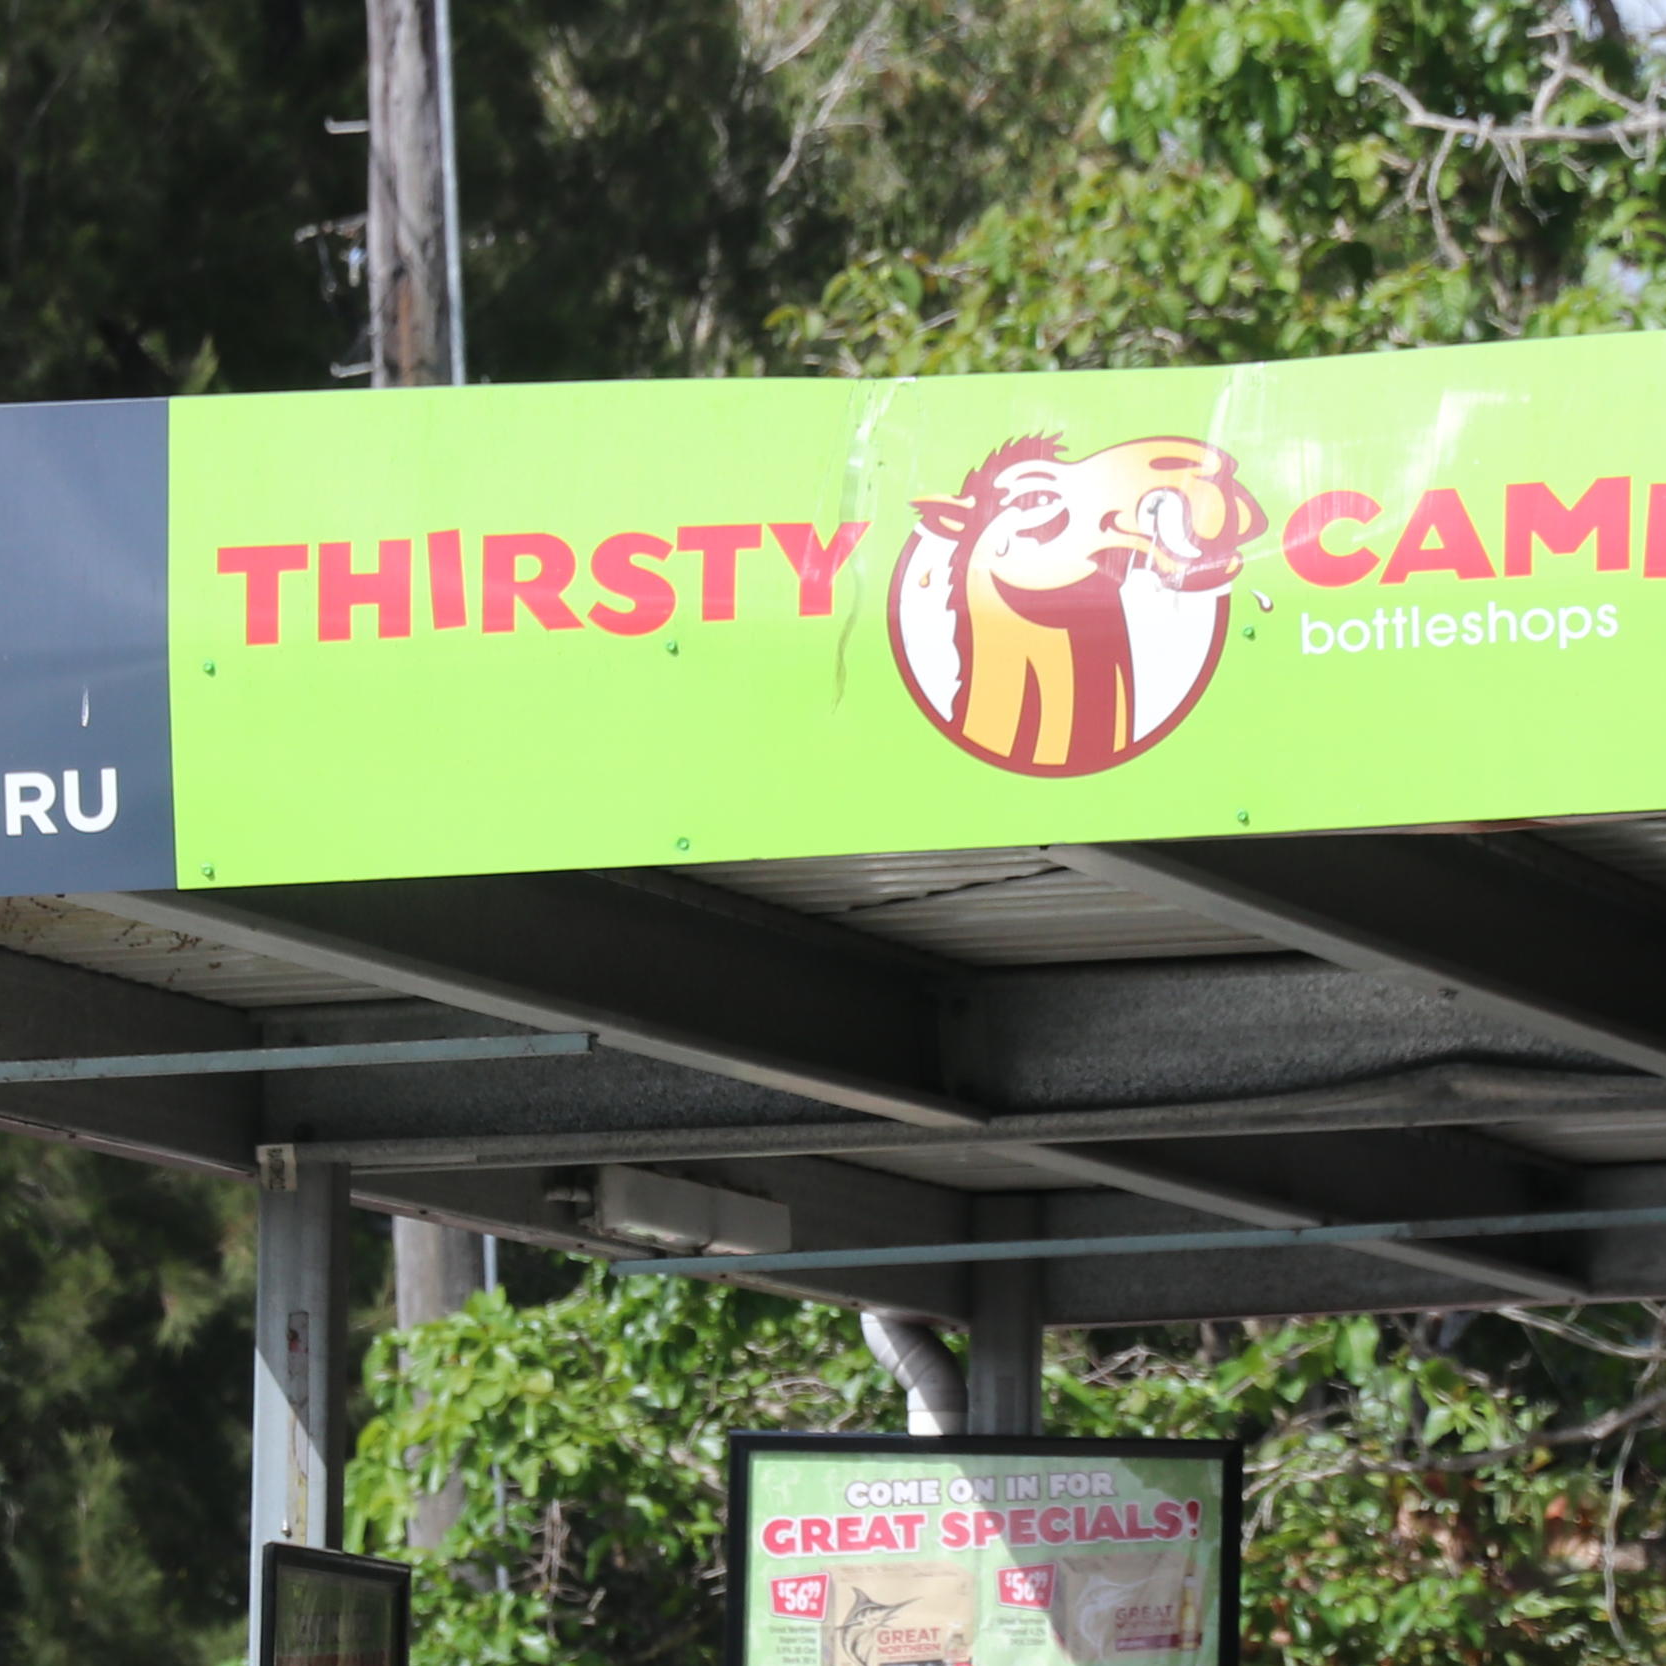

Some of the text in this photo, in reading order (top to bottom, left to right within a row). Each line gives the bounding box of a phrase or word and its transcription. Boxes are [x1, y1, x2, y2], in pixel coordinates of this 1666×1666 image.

[217, 521, 872, 646] THIRSTY
[1300, 601, 1619, 655] bottleshops
[845, 1471, 1117, 1508] COME ON IN FOR
[761, 1499, 1202, 1557] GREAT SPECIALS!
[876, 1627, 941, 1645] GREAT
